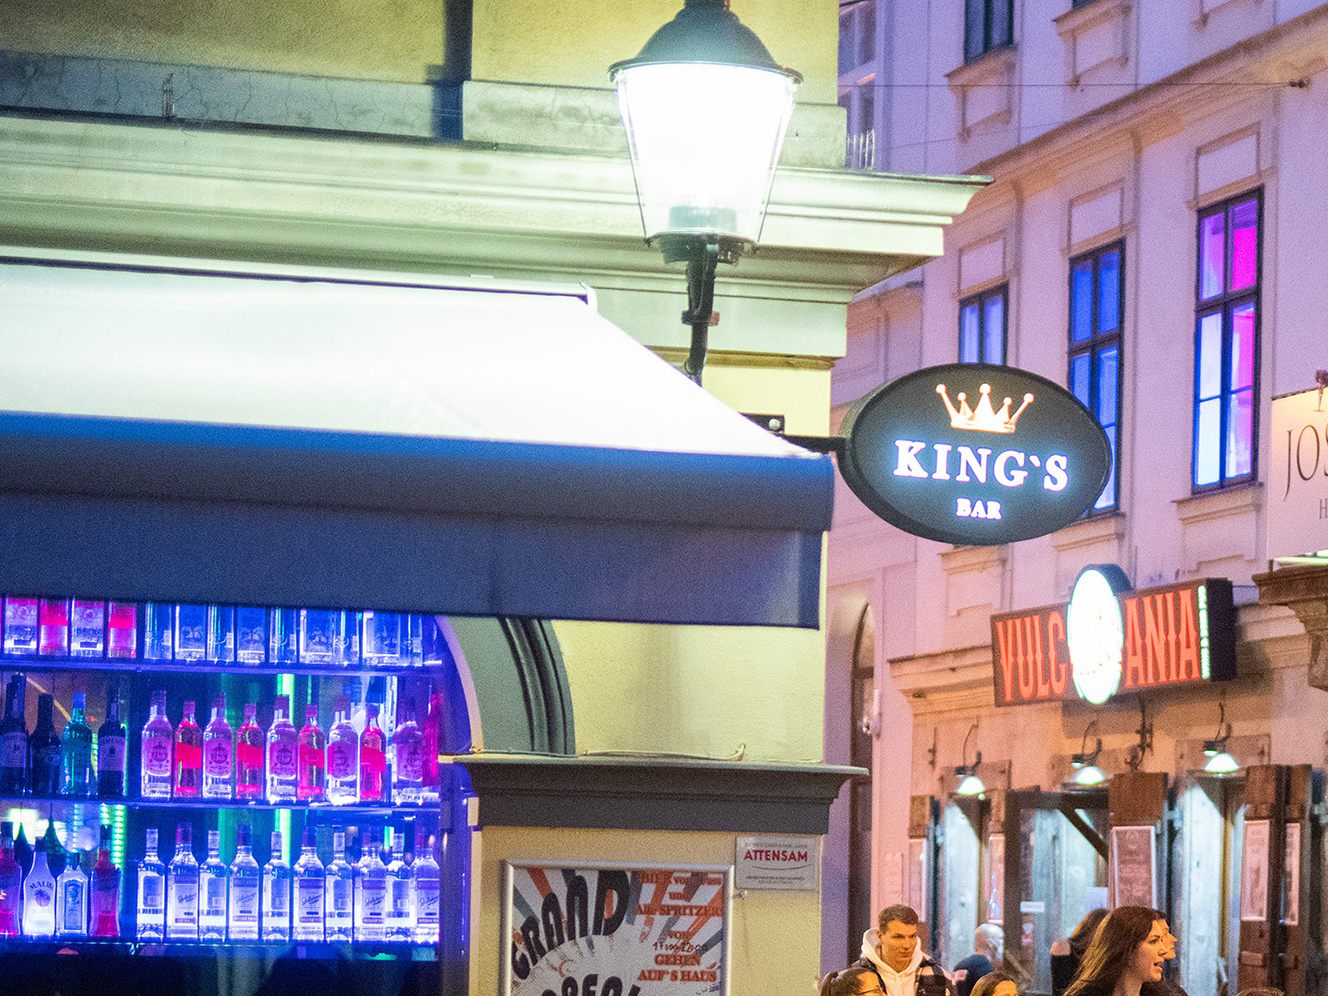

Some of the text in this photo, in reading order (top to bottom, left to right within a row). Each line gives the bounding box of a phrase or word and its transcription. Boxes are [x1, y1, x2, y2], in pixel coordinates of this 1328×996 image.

[956, 498, 1002, 520] BAR
[744, 849, 808, 861] ATTENSAM
[511, 870, 631, 981] GRAND
[655, 954, 701, 966] GEHEN
[680, 970, 717, 982] HAUS
